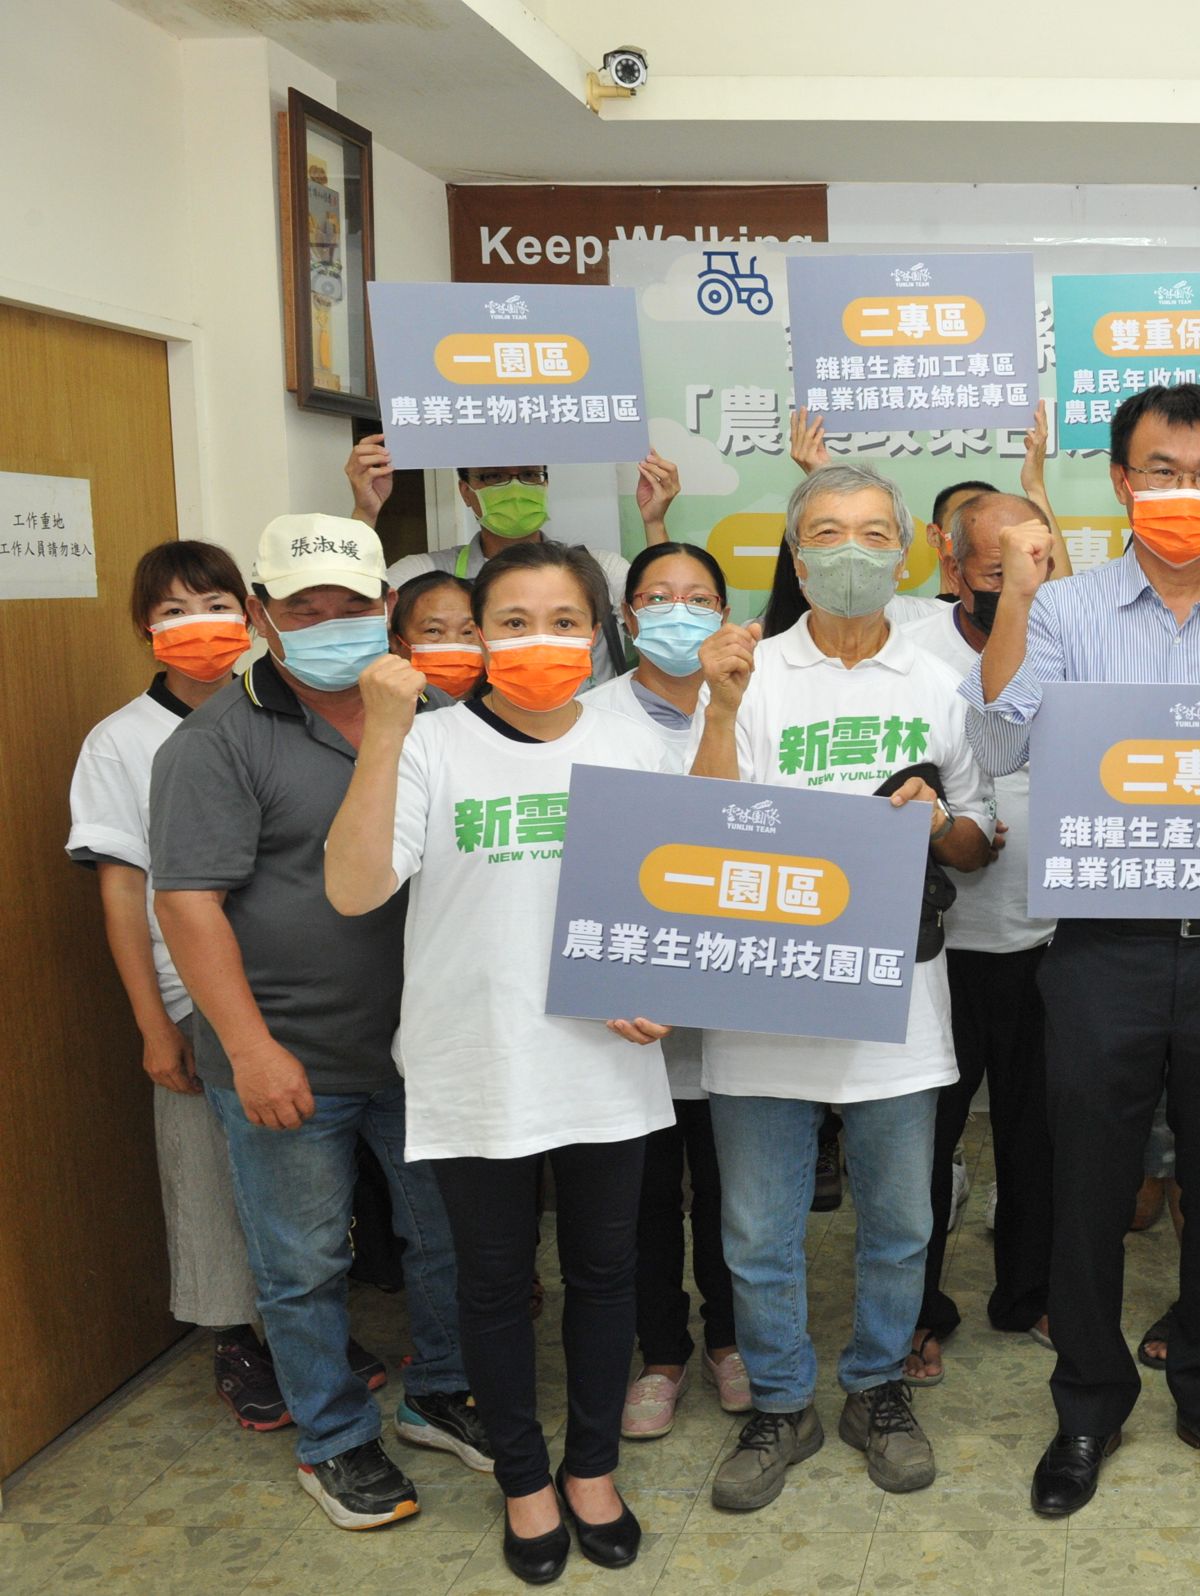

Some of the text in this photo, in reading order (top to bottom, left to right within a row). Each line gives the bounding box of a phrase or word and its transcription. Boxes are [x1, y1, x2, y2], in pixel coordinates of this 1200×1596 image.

[480, 226, 603, 274] Keep
[859, 302, 969, 340] 二專區
[452, 341, 573, 378] 一園區
[815, 352, 1016, 382] 雜糧生產加工專區
[390, 394, 641, 427] 農業生物科技園區
[806, 382, 1030, 414] 農業循環及綠能專區
[1064, 400, 1122, 425] 農民
[13, 511, 65, 530] 工作重地
[291, 535, 361, 561] 張淑媛
[779, 716, 930, 775] 新雲林
[808, 769, 892, 787] NEW YUNLIN
[488, 851, 524, 864] NEW
[663, 860, 824, 916] 一園區
[561, 919, 905, 987] 農業生物科技園區
